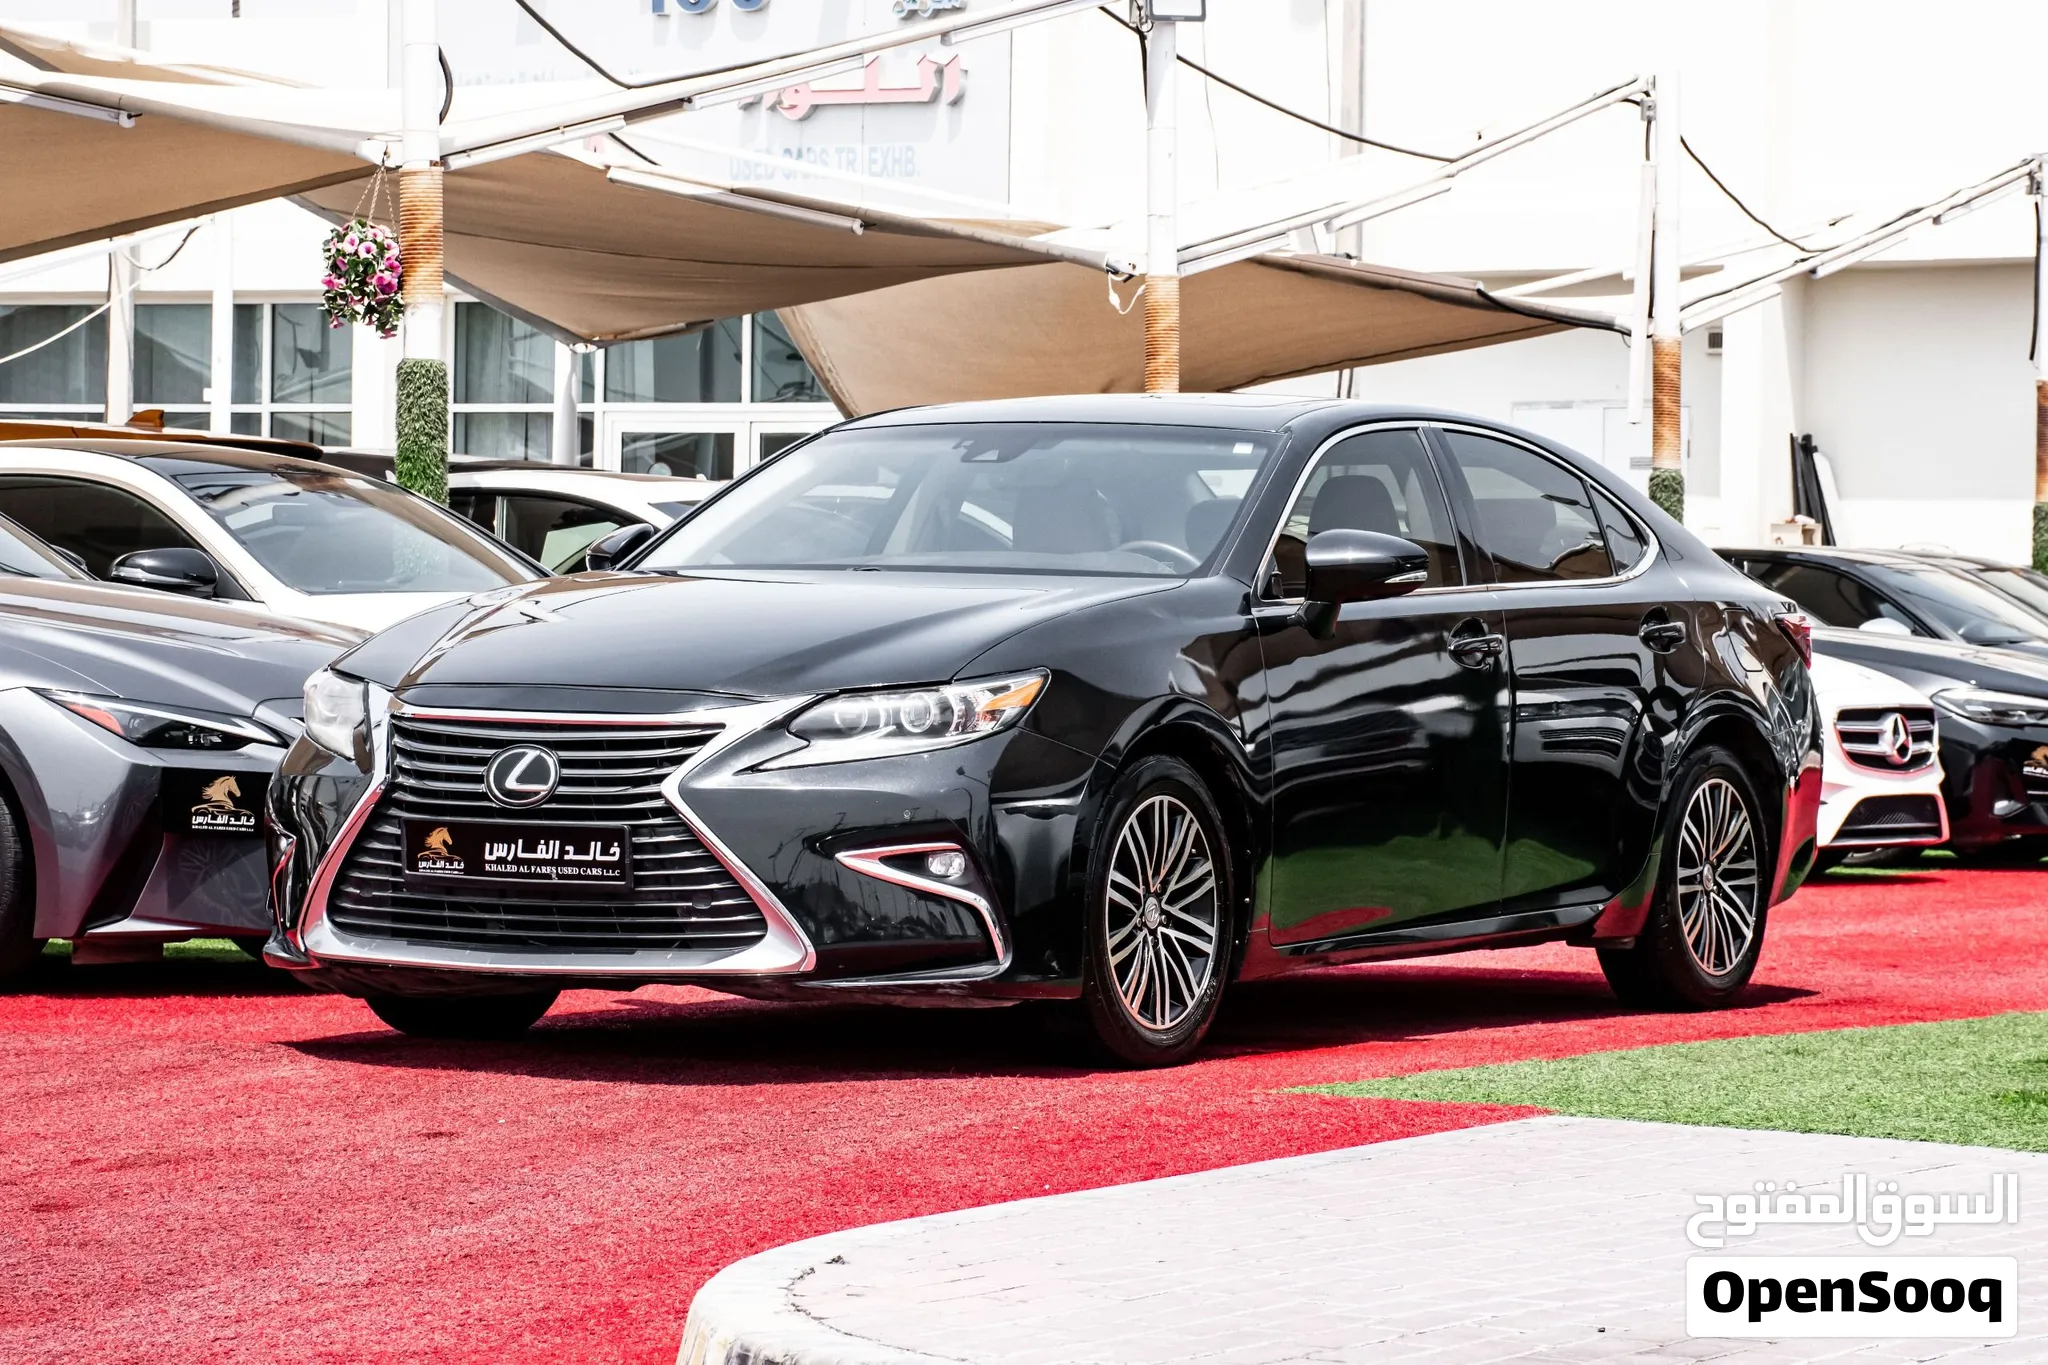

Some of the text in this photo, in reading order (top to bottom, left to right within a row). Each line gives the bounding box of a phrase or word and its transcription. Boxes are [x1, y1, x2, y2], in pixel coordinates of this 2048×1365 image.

[868, 145, 920, 179] EXHB.
[484, 839, 620, 862] خالد الفارس
[485, 863, 518, 873] KHALED
[518, 864, 530, 873] AL
[531, 865, 557, 874] FARES
[557, 866, 579, 875] USED
[580, 867, 603, 876] CARS
